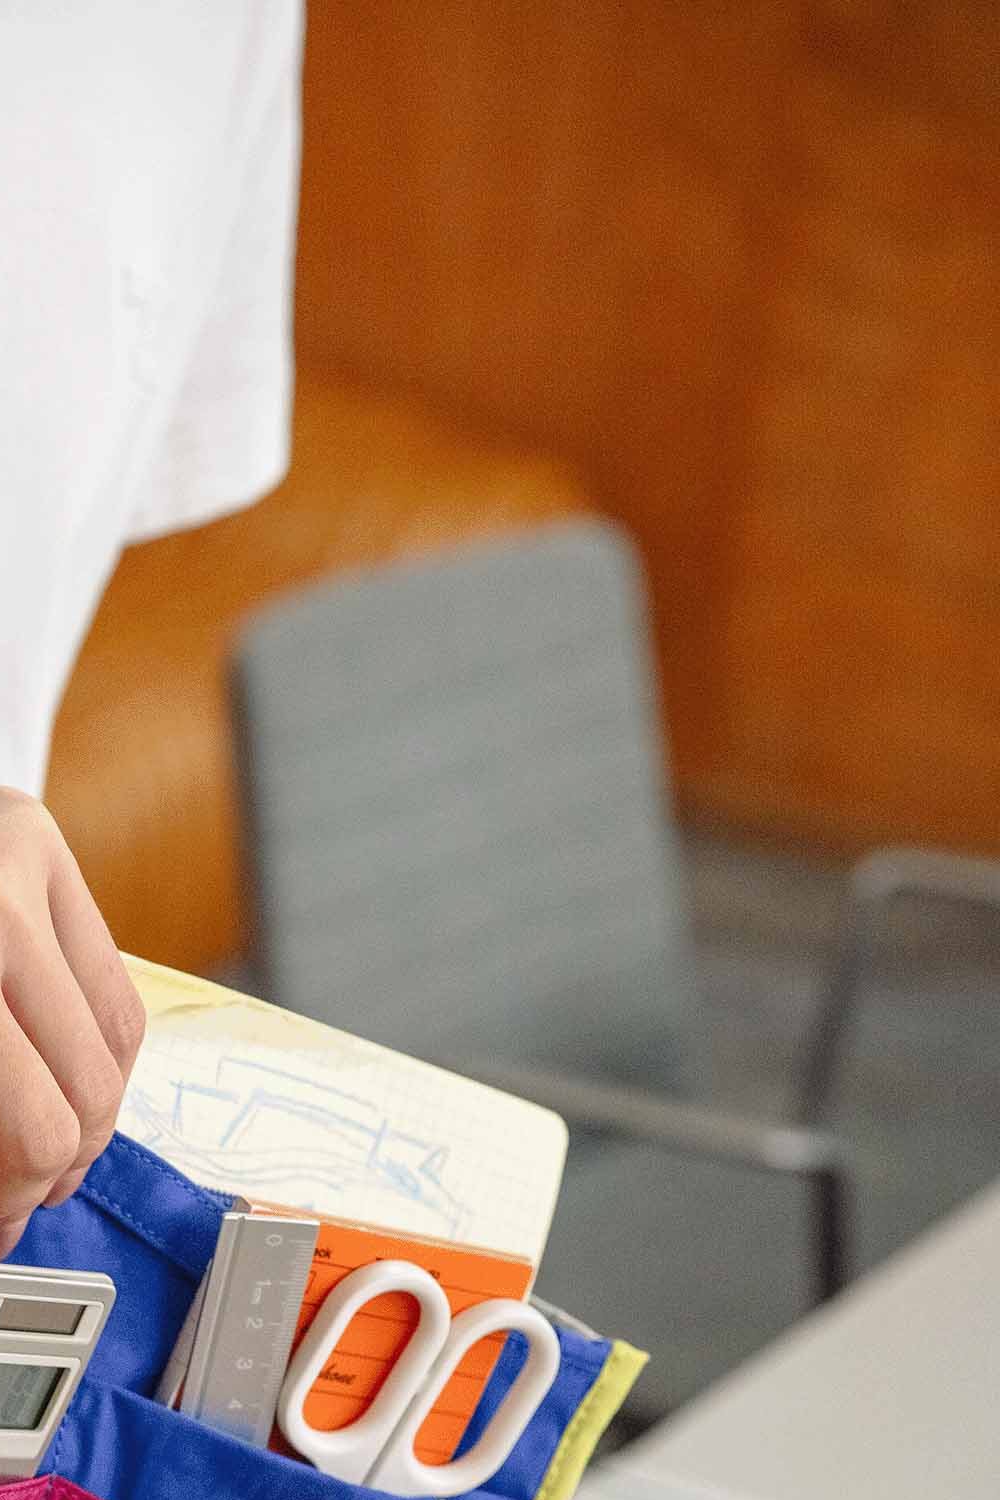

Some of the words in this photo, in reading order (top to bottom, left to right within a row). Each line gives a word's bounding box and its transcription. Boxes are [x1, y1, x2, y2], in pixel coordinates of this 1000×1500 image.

[265, 1234, 283, 1247] 0
[247, 1316, 264, 1329] 2
[236, 1358, 254, 1370] 3
